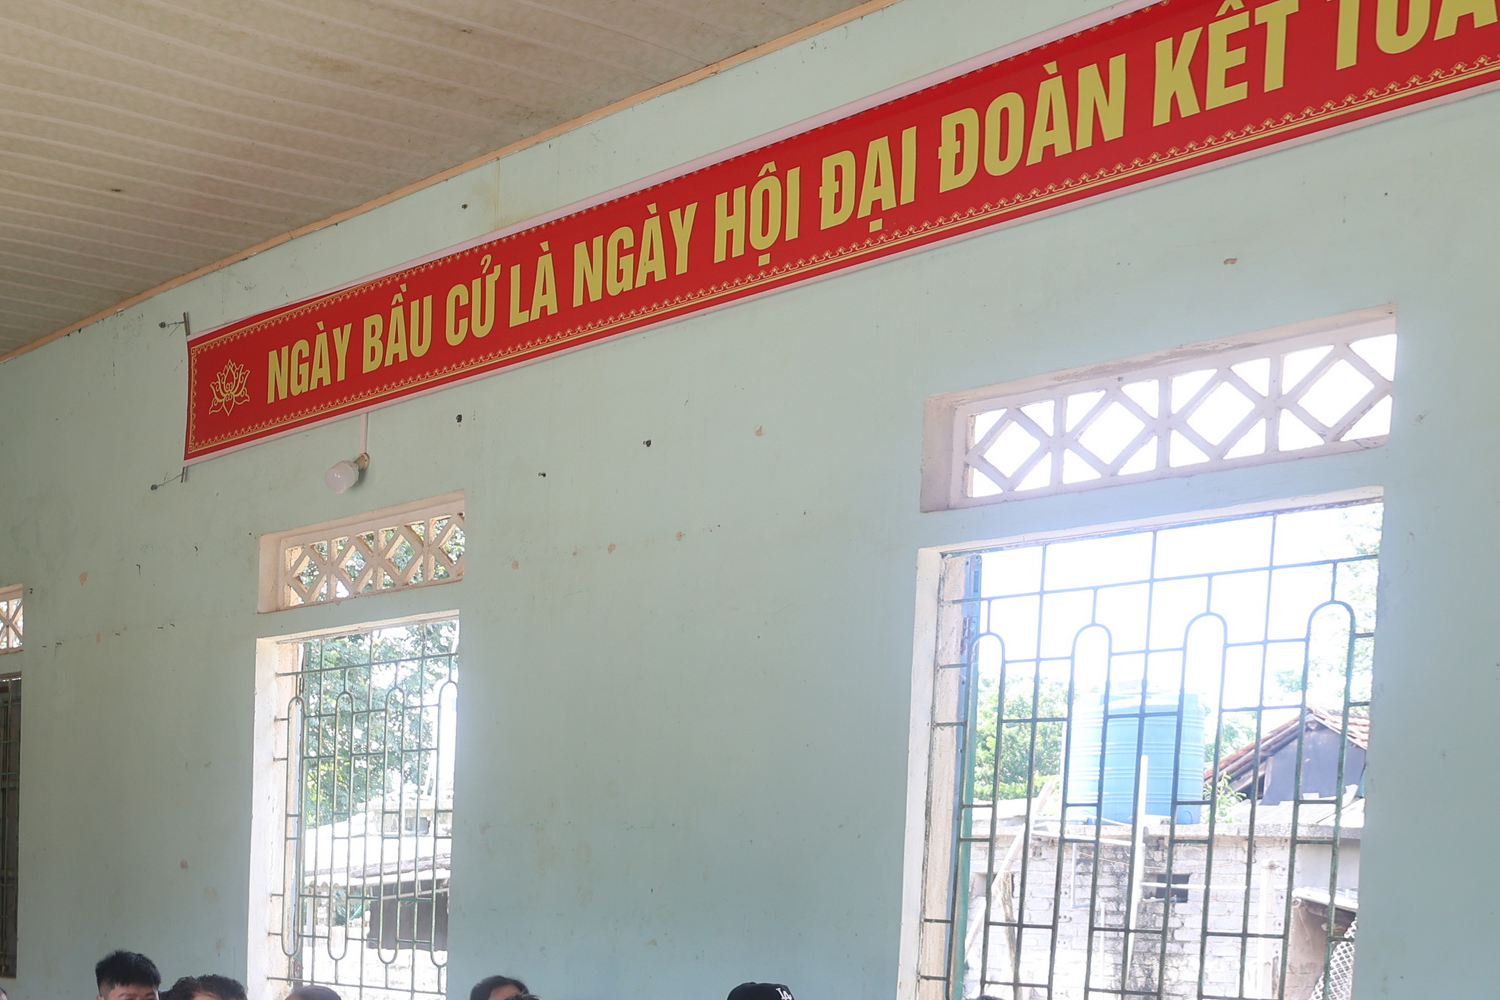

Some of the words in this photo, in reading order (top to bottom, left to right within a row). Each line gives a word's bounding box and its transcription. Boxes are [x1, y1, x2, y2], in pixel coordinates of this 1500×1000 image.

[267, 321, 353, 404] NGÀY
[362, 283, 433, 374] BẦU
[445, 254, 501, 348] CỬ
[509, 241, 559, 328] LÀ
[572, 203, 699, 308] NGÀY
[713, 161, 801, 267] HỘI
[818, 125, 918, 233] ĐẠI
[938, 60, 1127, 193] ĐOÀN
